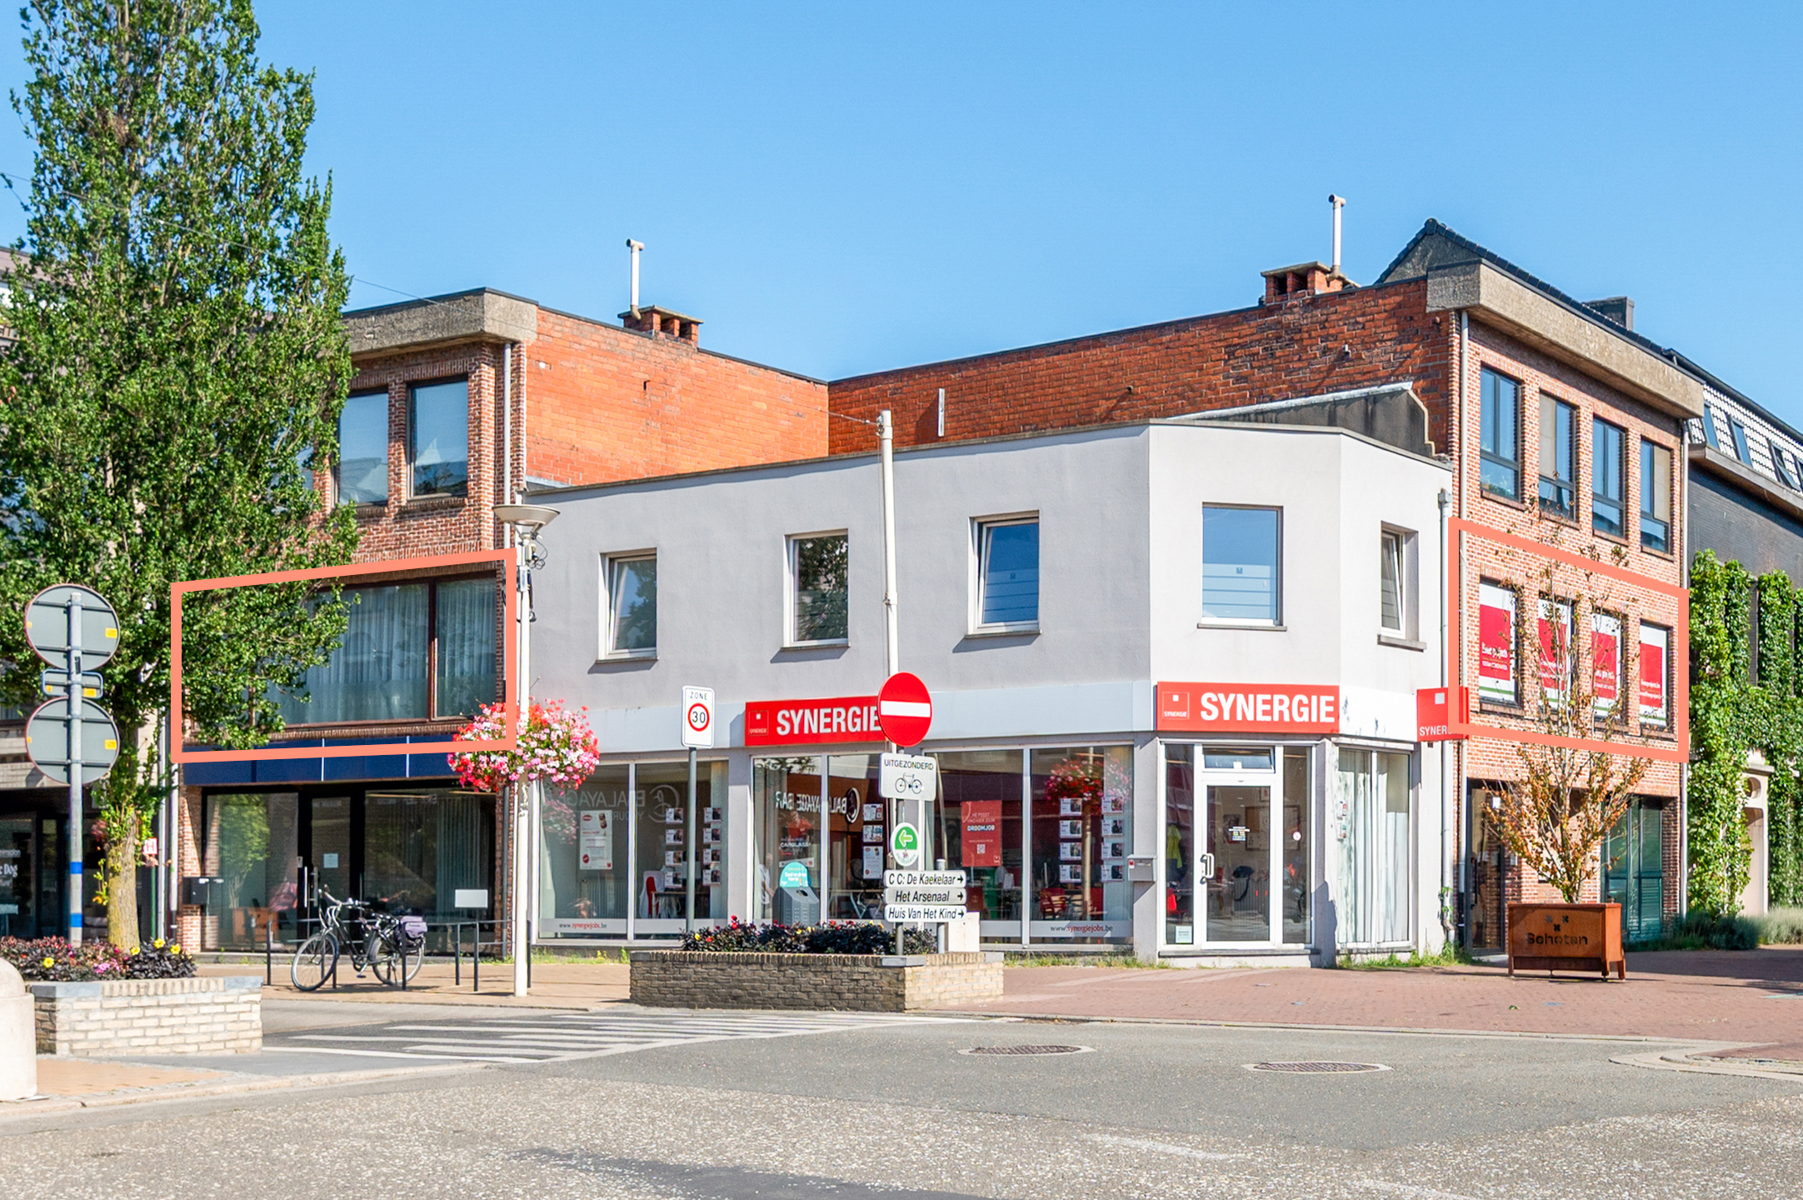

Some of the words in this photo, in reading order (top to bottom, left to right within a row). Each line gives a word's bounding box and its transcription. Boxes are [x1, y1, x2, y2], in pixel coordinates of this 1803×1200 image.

[690, 691, 707, 700] ZONE
[1201, 692, 1335, 723] SYNERGIE
[692, 711, 706, 724] 30
[776, 706, 883, 735] SYNERGIE
[1419, 725, 1452, 736] SYNER
[884, 759, 934, 770] UITGEZONDERD
[146, 841, 154, 851] H
[889, 874, 895, 885] C
[907, 874, 917, 885] De
[919, 874, 956, 885] Kaekelaar
[895, 890, 910, 902] Het
[912, 890, 950, 902] Arsenaal
[888, 907, 906, 919] Huis
[908, 907, 921, 919] Van
[923, 908, 937, 919] Het
[939, 908, 956, 919] Kind
[1527, 932, 1588, 945] Schoten
